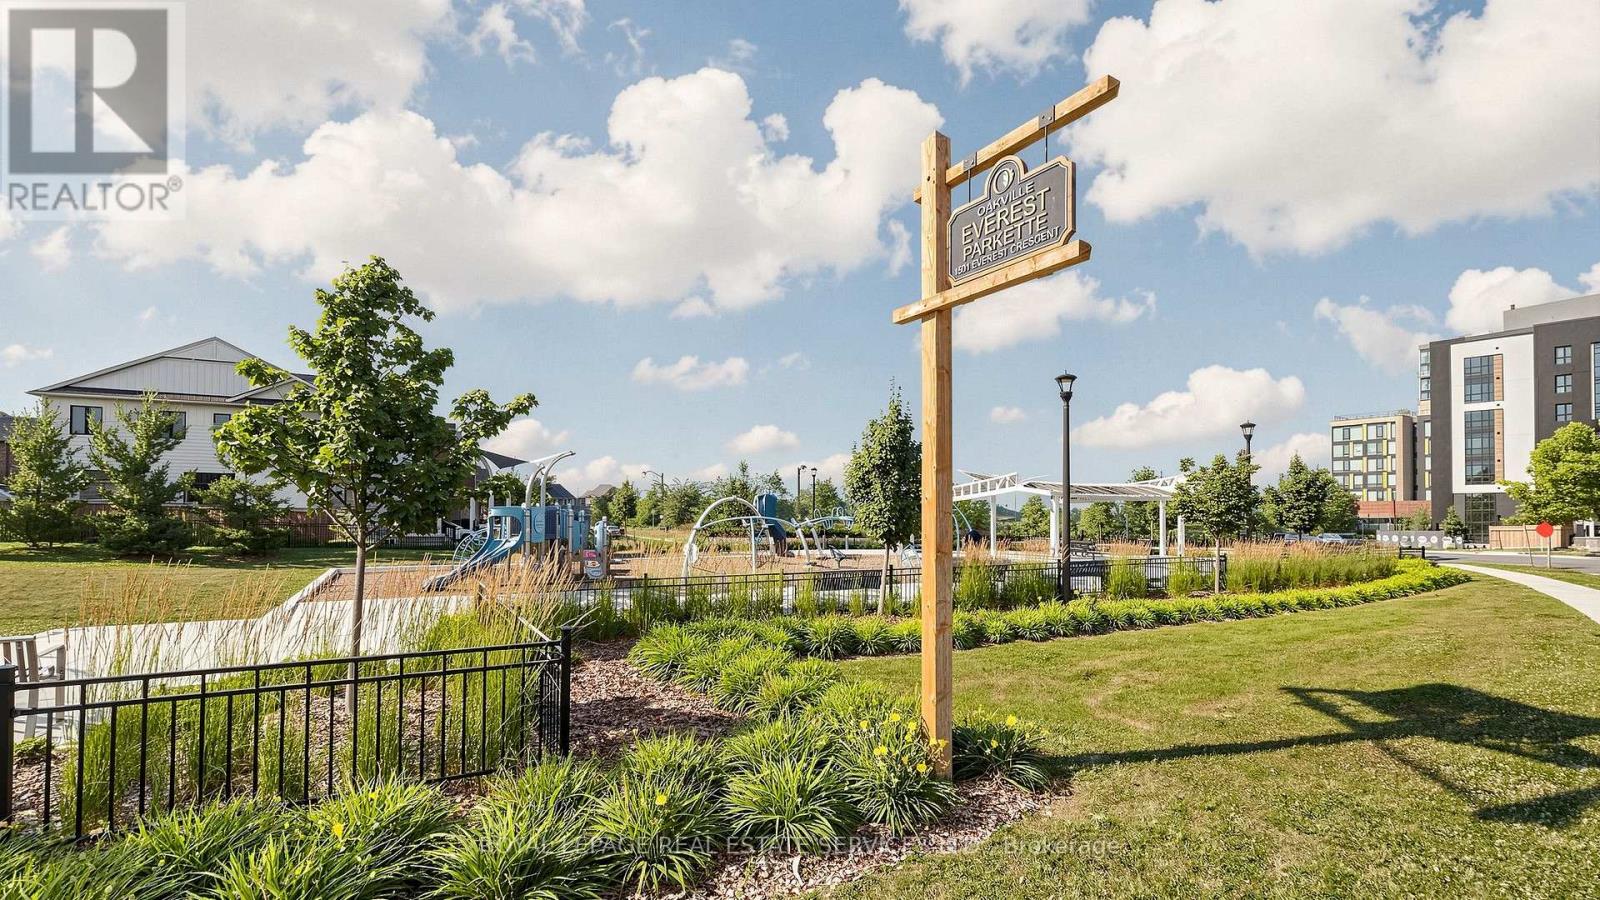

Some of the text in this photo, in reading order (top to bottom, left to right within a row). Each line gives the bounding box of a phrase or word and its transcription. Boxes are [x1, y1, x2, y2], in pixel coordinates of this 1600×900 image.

[962, 187, 1051, 245] EVEREST
[977, 181, 1035, 216] OAKVILLE
[954, 226, 1060, 276] 1501 EVEREST CRESCENT
[963, 212, 1048, 261] PARKETTE
